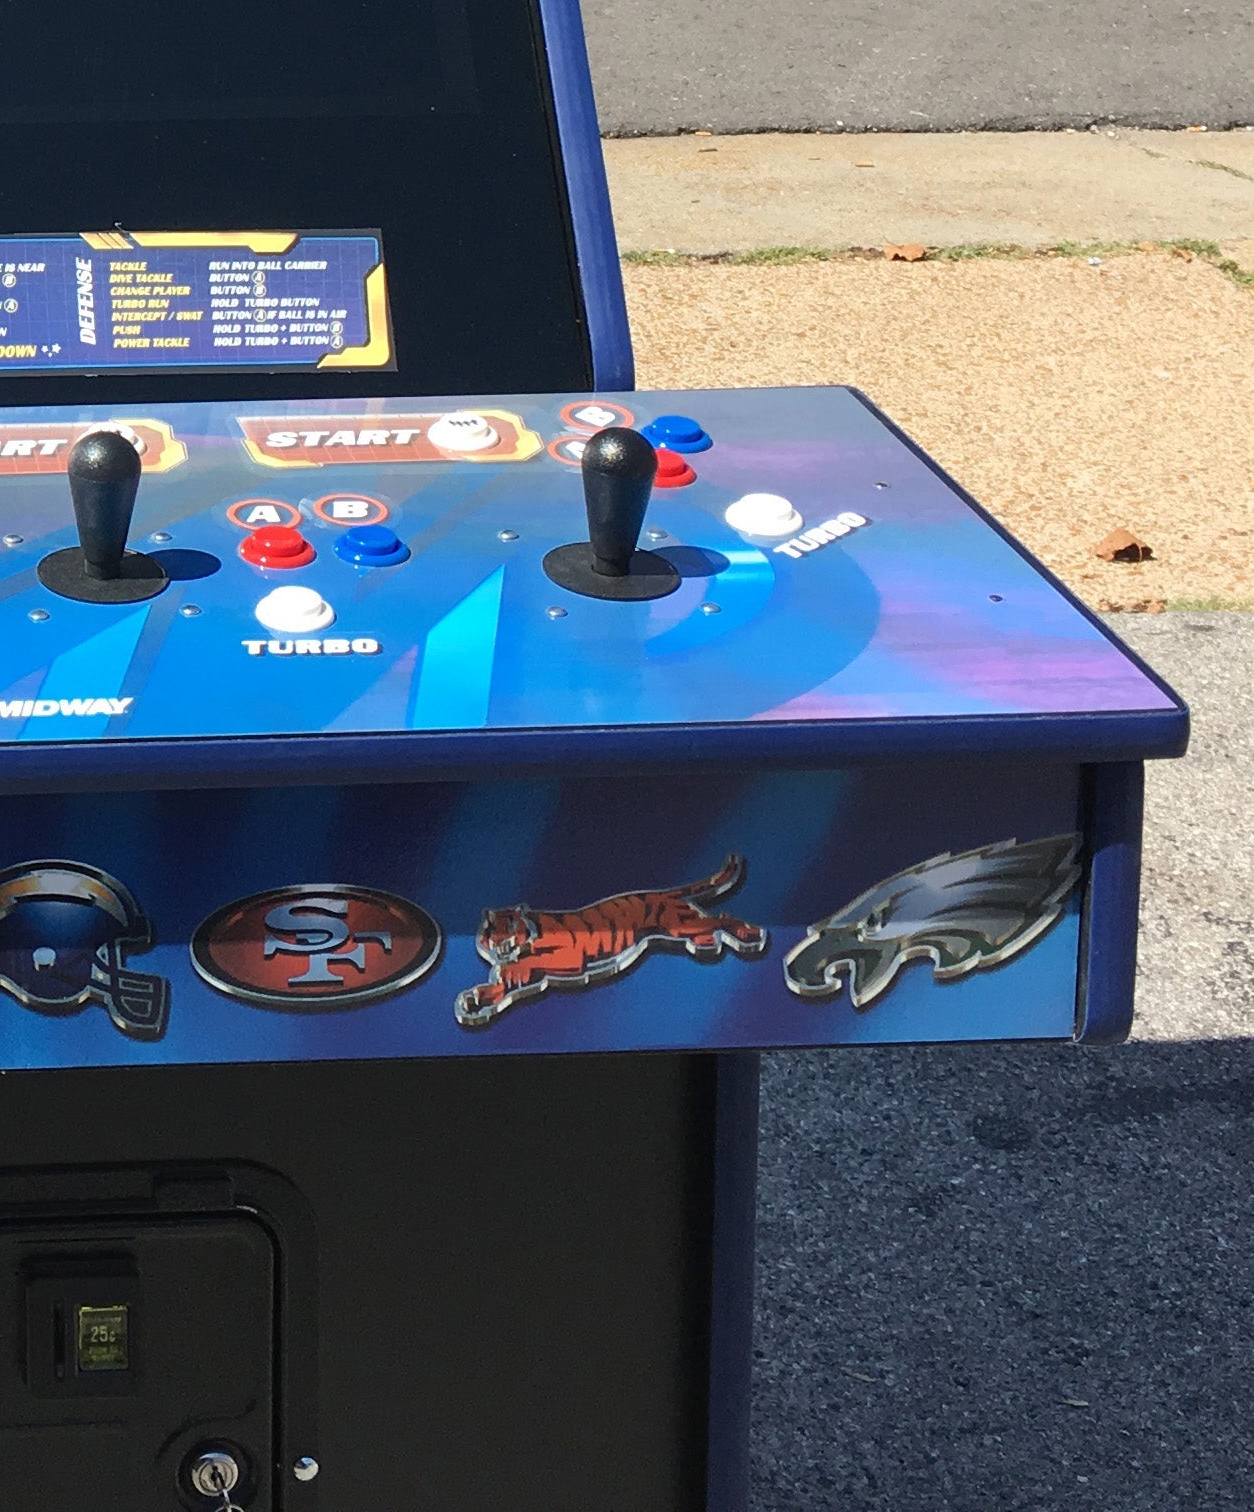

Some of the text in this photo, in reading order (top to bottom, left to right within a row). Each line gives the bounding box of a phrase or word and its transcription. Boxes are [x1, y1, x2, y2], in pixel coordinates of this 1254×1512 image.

[209, 261, 327, 270] RUN INTO BALL CARRIER
[136, 274, 173, 282] TACKLE
[209, 274, 249, 282] BUTTON
[153, 286, 191, 295] PLAYER
[210, 286, 250, 294] BUTTON
[76, 257, 96, 345] DEFENSE
[112, 300, 146, 308] TURBO
[211, 298, 320, 307] HOLD TURBO BUTTON
[212, 311, 252, 320] BUTTON
[267, 311, 277, 319] IF
[279, 310, 302, 319] BALL
[213, 325, 241, 333] HOLD
[245, 324, 279, 333] TURBO
[289, 324, 329, 332] BUTTON
[114, 338, 190, 348] POWER TACKLE
[214, 337, 241, 346] HOLD
[245, 337, 279, 345] TURBO
[290, 336, 329, 345] BUTTON
[575, 406, 615, 427] B
[266, 429, 420, 448] START
[246, 501, 368, 522] A B
[773, 512, 866, 558] TURBO
[241, 638, 381, 655] TURBO
[264, 898, 392, 986] SF
